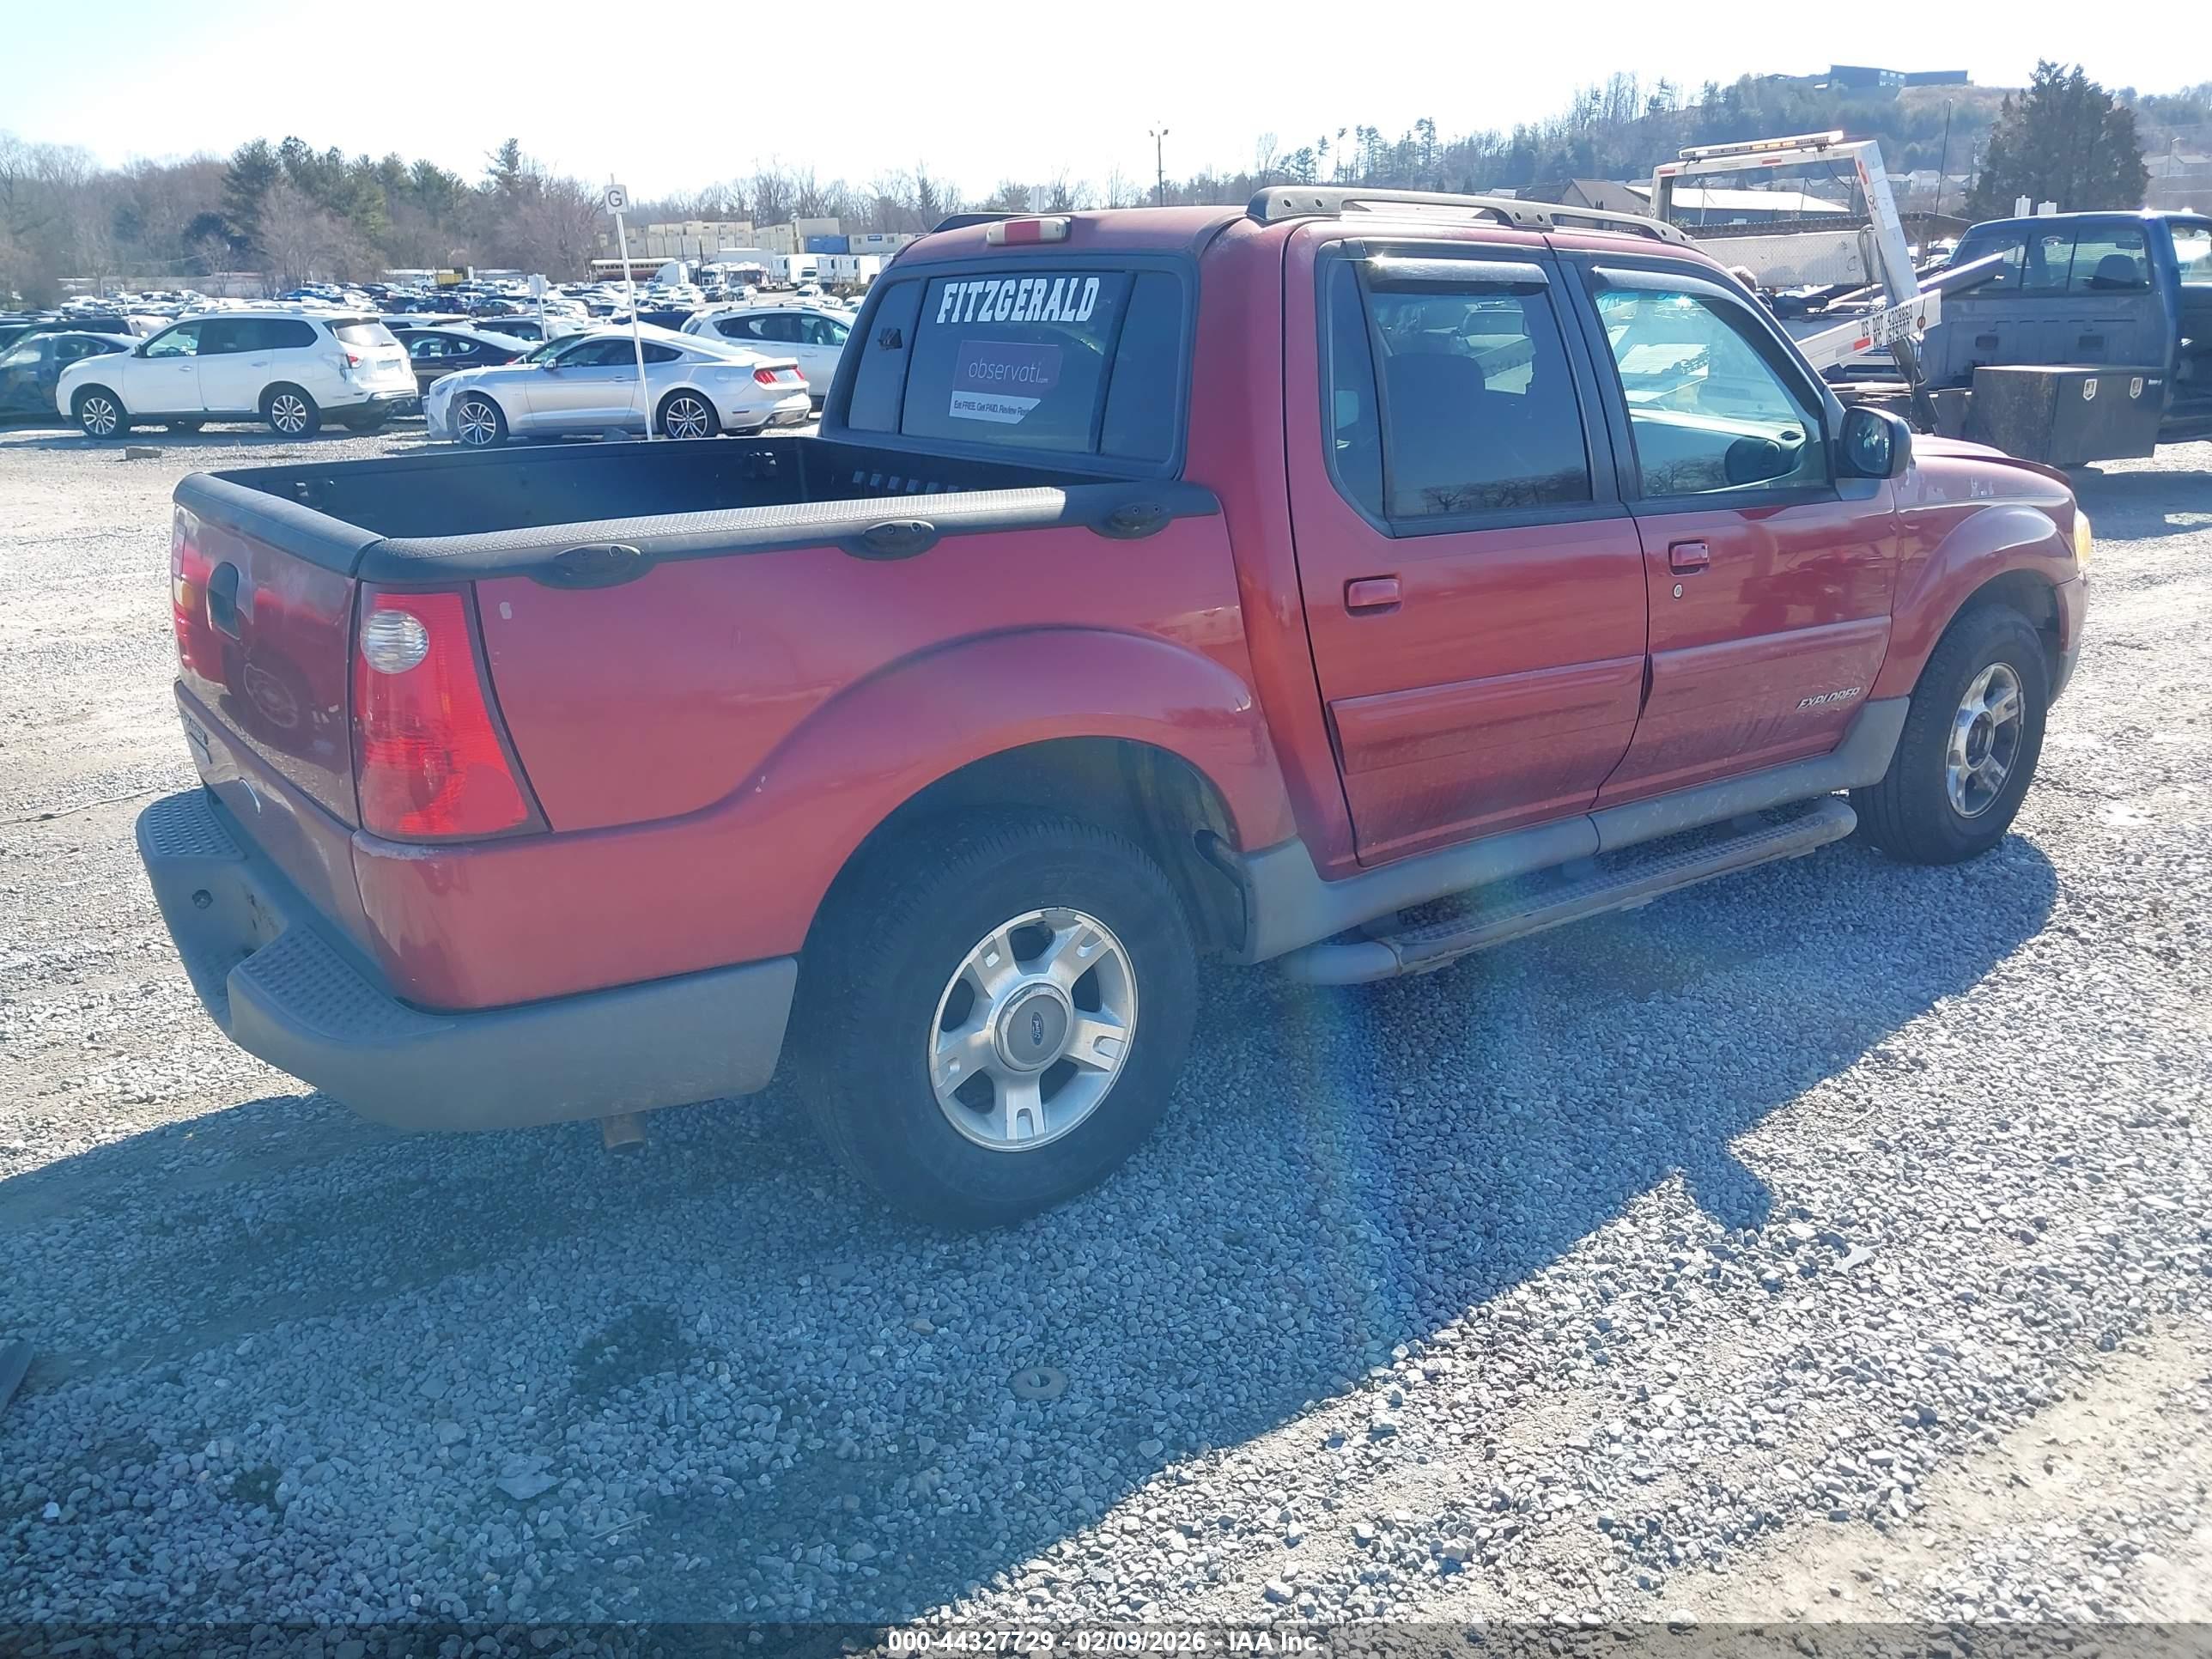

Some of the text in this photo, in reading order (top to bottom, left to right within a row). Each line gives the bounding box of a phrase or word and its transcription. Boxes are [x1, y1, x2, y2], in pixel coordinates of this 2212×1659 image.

[608, 190, 623, 208] G
[936, 277, 1099, 324] FITZGERALD
[1861, 320, 1869, 337] US
[1872, 314, 1884, 333] DOT
[1873, 331, 1882, 349] MC
[1796, 687, 1862, 710] EXPLORER
